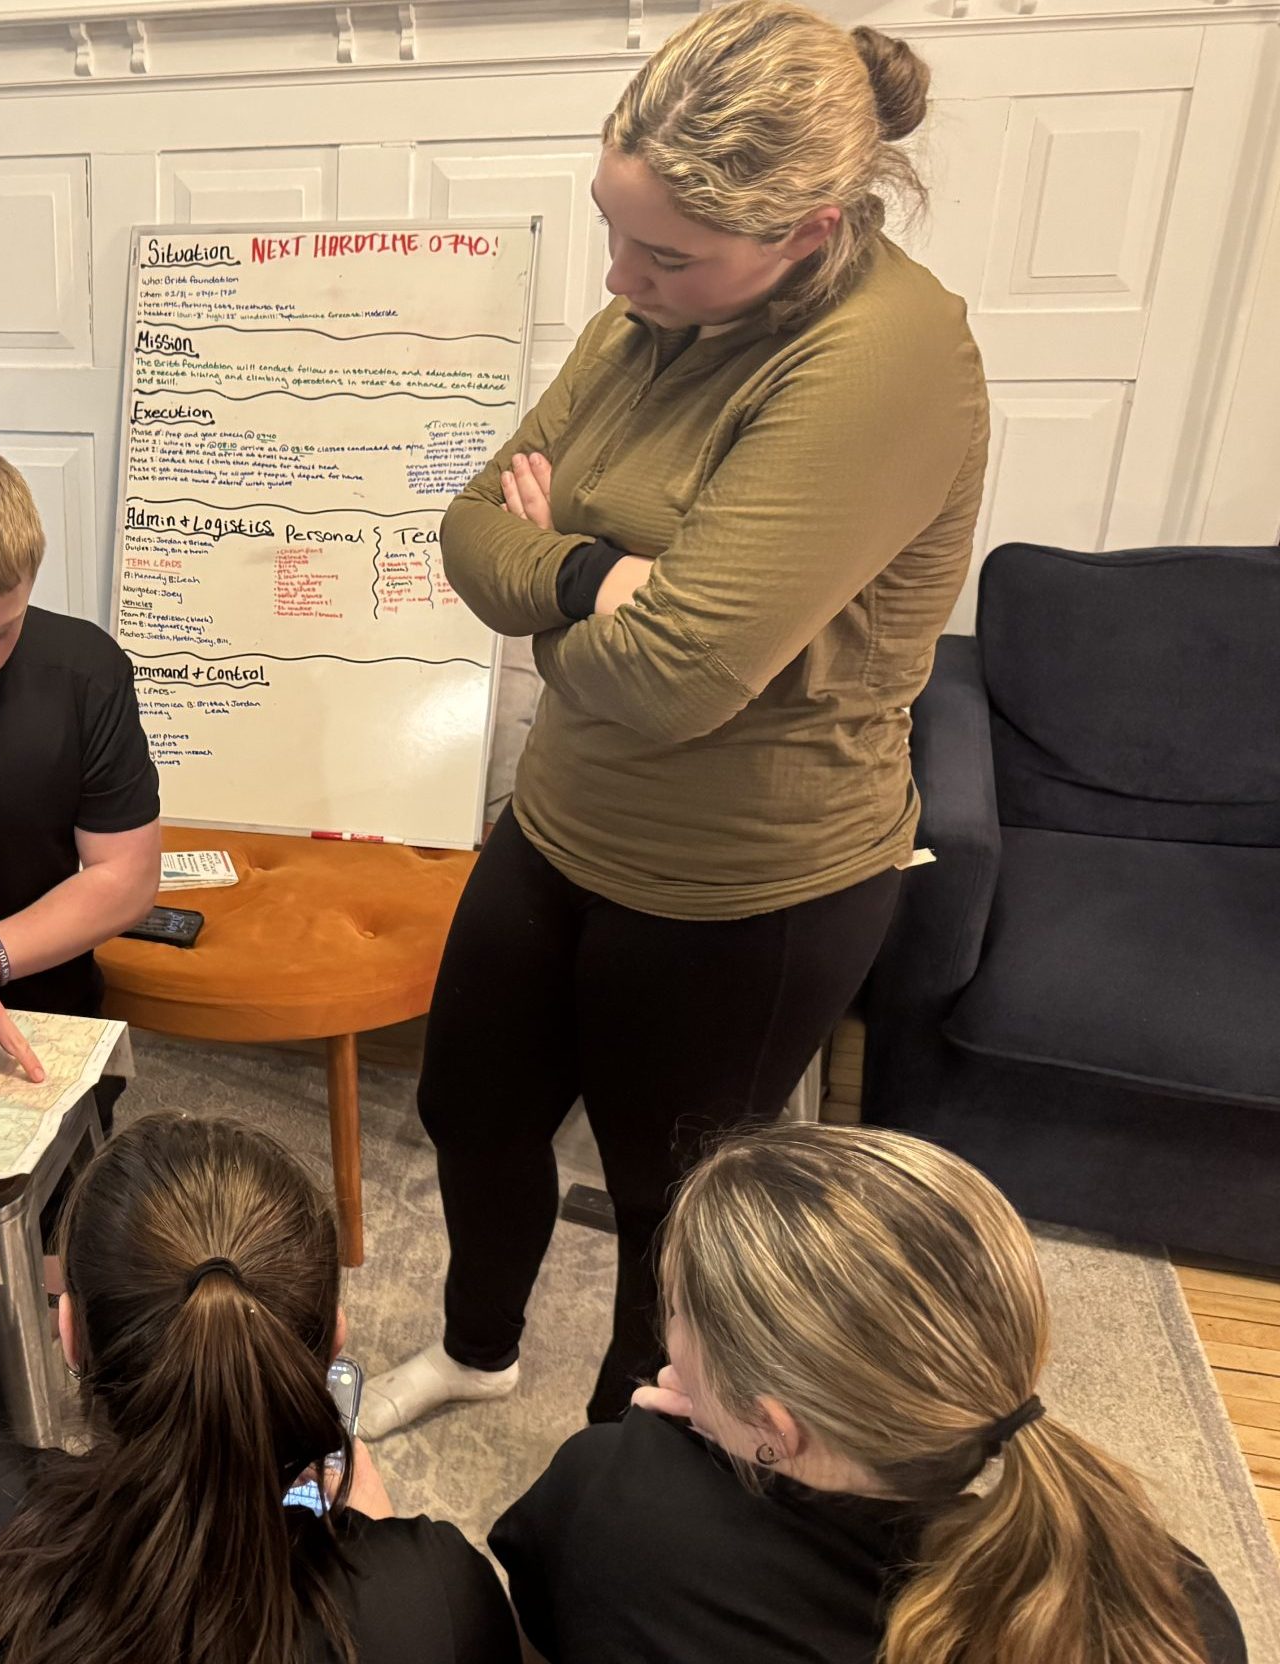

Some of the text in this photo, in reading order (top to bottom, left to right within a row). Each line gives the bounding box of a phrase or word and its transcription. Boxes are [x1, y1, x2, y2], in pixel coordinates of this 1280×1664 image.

[148, 239, 235, 265] Situation
[251, 233, 499, 264] NEXT HARDTIME 0740!
[137, 330, 195, 353] Mission
[136, 358, 152, 367] The
[153, 359, 180, 368] Britt
[259, 364, 294, 372] conduct
[298, 364, 327, 374] follow
[342, 368, 398, 376] instruction
[426, 370, 472, 378] education
[136, 368, 148, 376] as
[190, 371, 223, 385] hiking
[246, 374, 289, 390] climbing
[292, 378, 344, 386] operations
[451, 382, 506, 391] confidence
[134, 401, 213, 420] Execution
[127, 507, 176, 527] Admin
[193, 516, 273, 541] Logistics
[286, 524, 365, 544] Personal
[393, 528, 441, 545] Tea
[126, 558, 182, 568] TEAM LEADS
[120, 610, 138, 618] Team
[120, 618, 138, 626] Team
[133, 664, 189, 679] ommand
[206, 666, 265, 681] Control
[140, 710, 172, 720] ennedy
